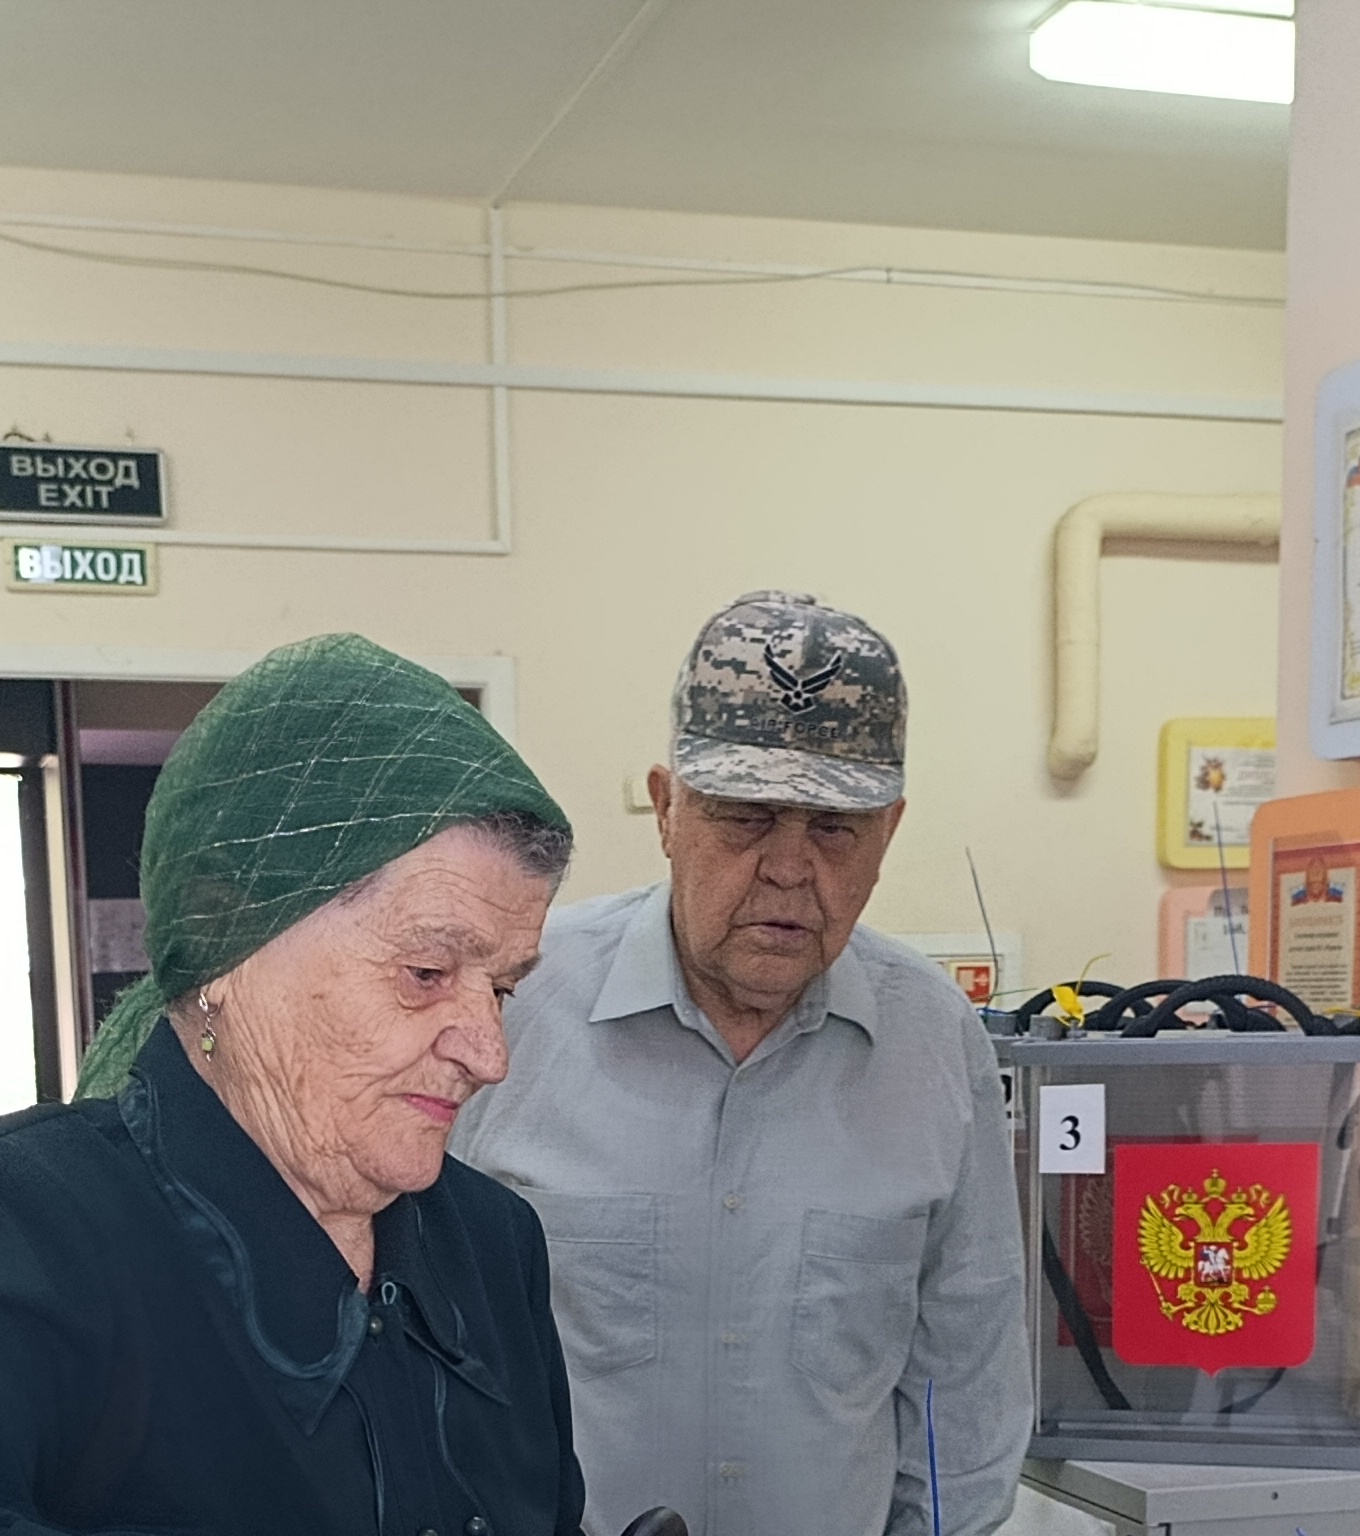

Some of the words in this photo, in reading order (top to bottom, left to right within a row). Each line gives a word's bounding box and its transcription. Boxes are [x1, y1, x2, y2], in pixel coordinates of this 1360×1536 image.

[11, 455, 141, 489] ВЫХОД
[39, 484, 114, 508] EXIT
[17, 546, 144, 584] ВЫХОД
[1059, 1115, 1082, 1151] 3
